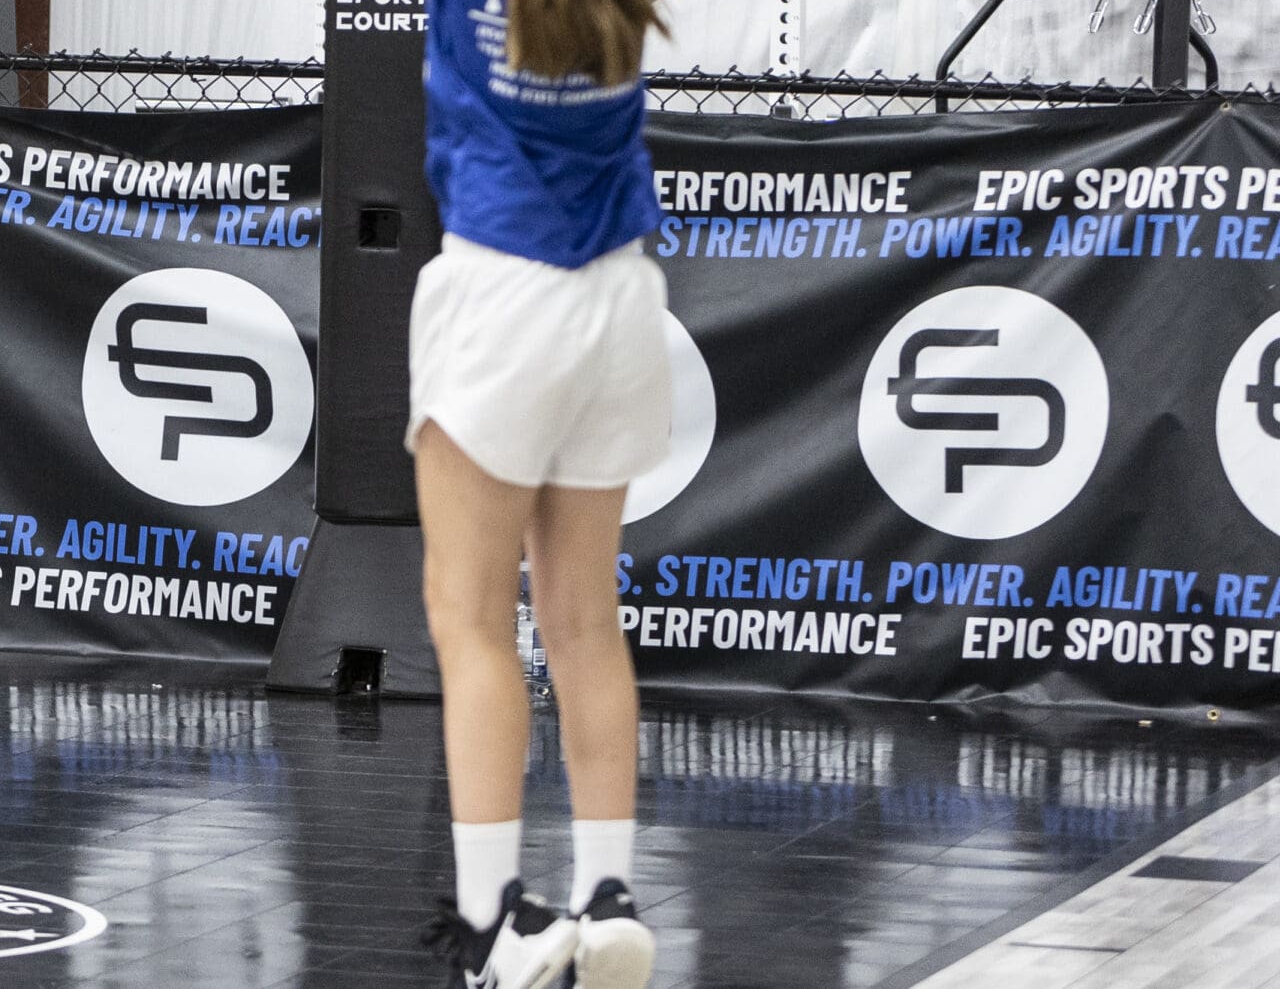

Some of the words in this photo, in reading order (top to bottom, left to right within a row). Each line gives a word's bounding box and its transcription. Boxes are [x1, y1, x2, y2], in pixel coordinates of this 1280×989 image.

[22, 147, 291, 201] PERFORMANCE
[974, 169, 1065, 211] EPIC
[1073, 165, 1230, 210] SPORTS
[46, 195, 201, 243] AGILITY.
[213, 204, 321, 248] REAC
[657, 216, 867, 259] STRENGTH.
[878, 216, 1031, 258] POWER.
[1044, 214, 1202, 258] AGILITY.
[56, 518, 200, 571] AGILITY.
[11, 566, 278, 626] PERFORMANCE
[656, 555, 872, 603] STRENGTH.
[886, 561, 1033, 608] POWER.
[1046, 565, 1202, 613] AGILITY.
[617, 605, 902, 657] PERFORMANCE
[962, 616, 1058, 661] EPIC
[1064, 620, 1215, 667] SPORTS
